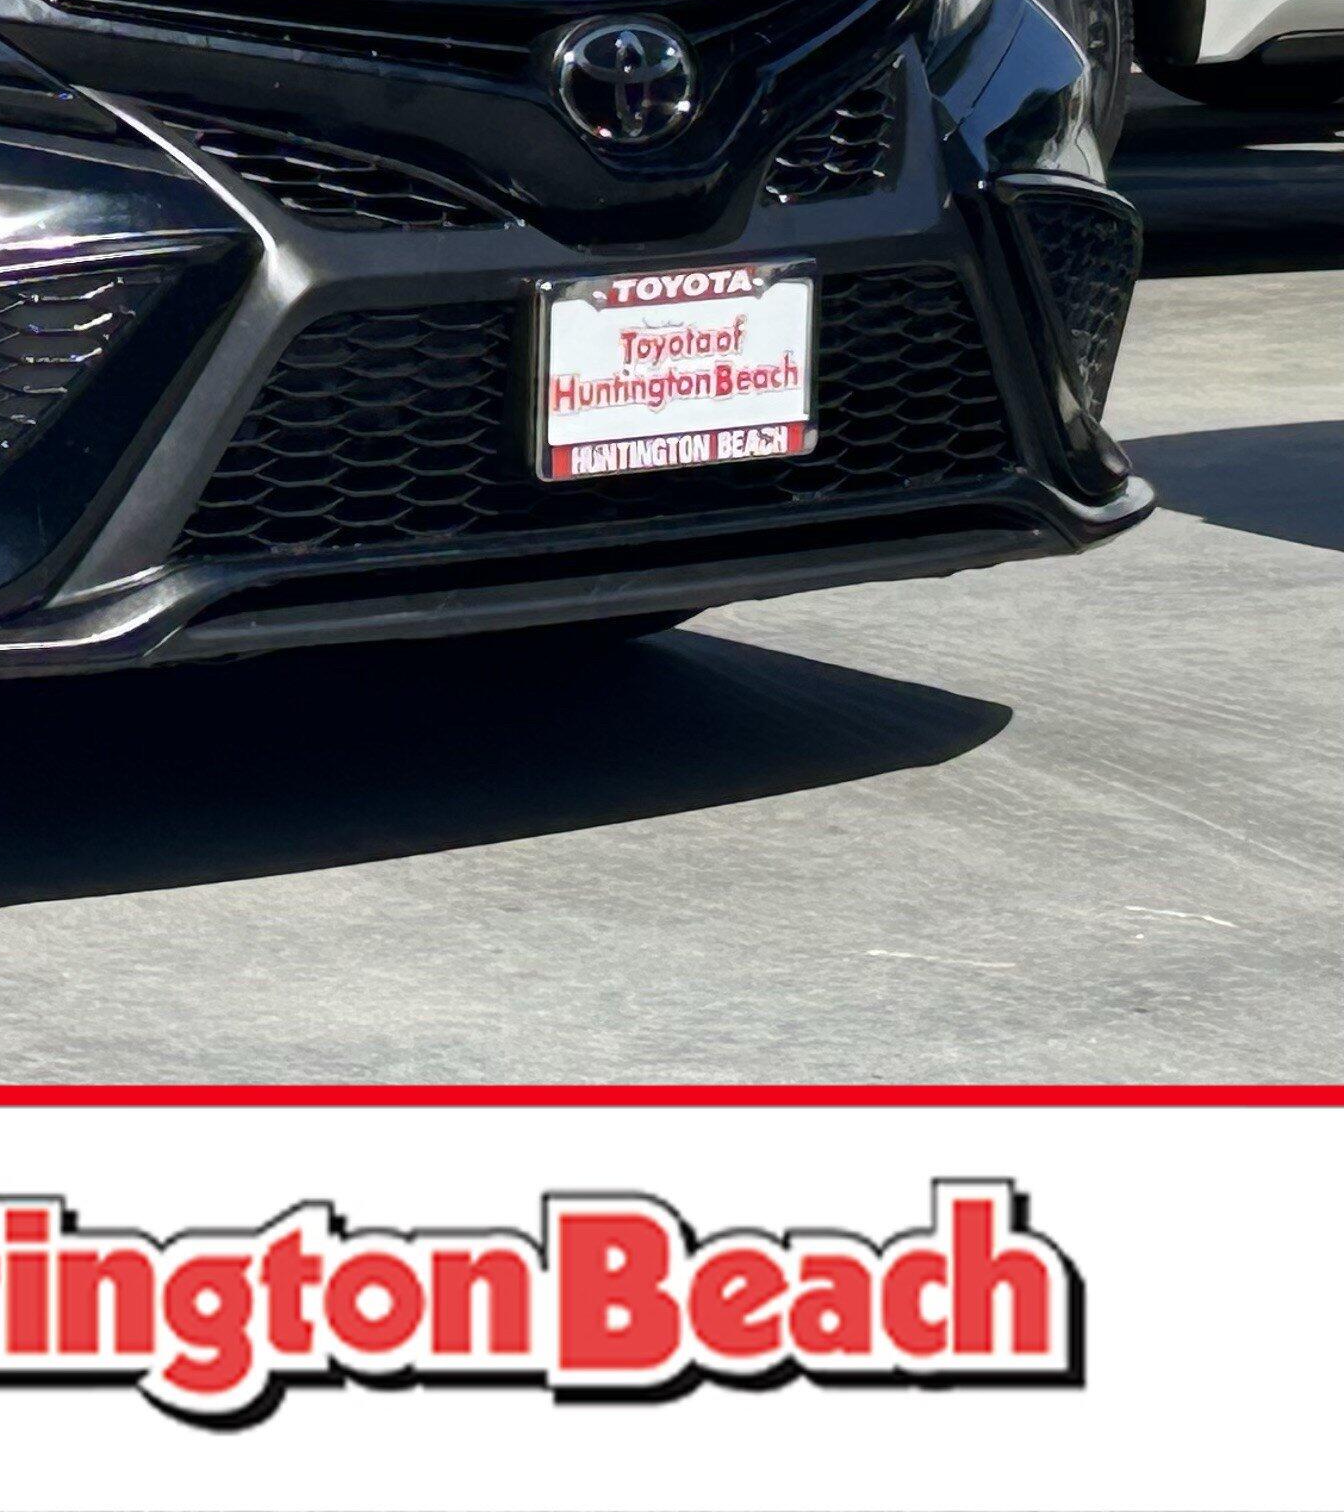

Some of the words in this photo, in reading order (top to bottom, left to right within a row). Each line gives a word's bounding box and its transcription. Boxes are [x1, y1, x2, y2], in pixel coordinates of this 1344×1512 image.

[612, 269, 752, 303] TOYOTA
[619, 327, 713, 366] Toyota
[715, 316, 745, 354] of
[552, 369, 711, 413] Huntington
[715, 353, 799, 398] Beach
[571, 435, 710, 475] HUNTINGTON
[717, 426, 788, 460] BEACH
